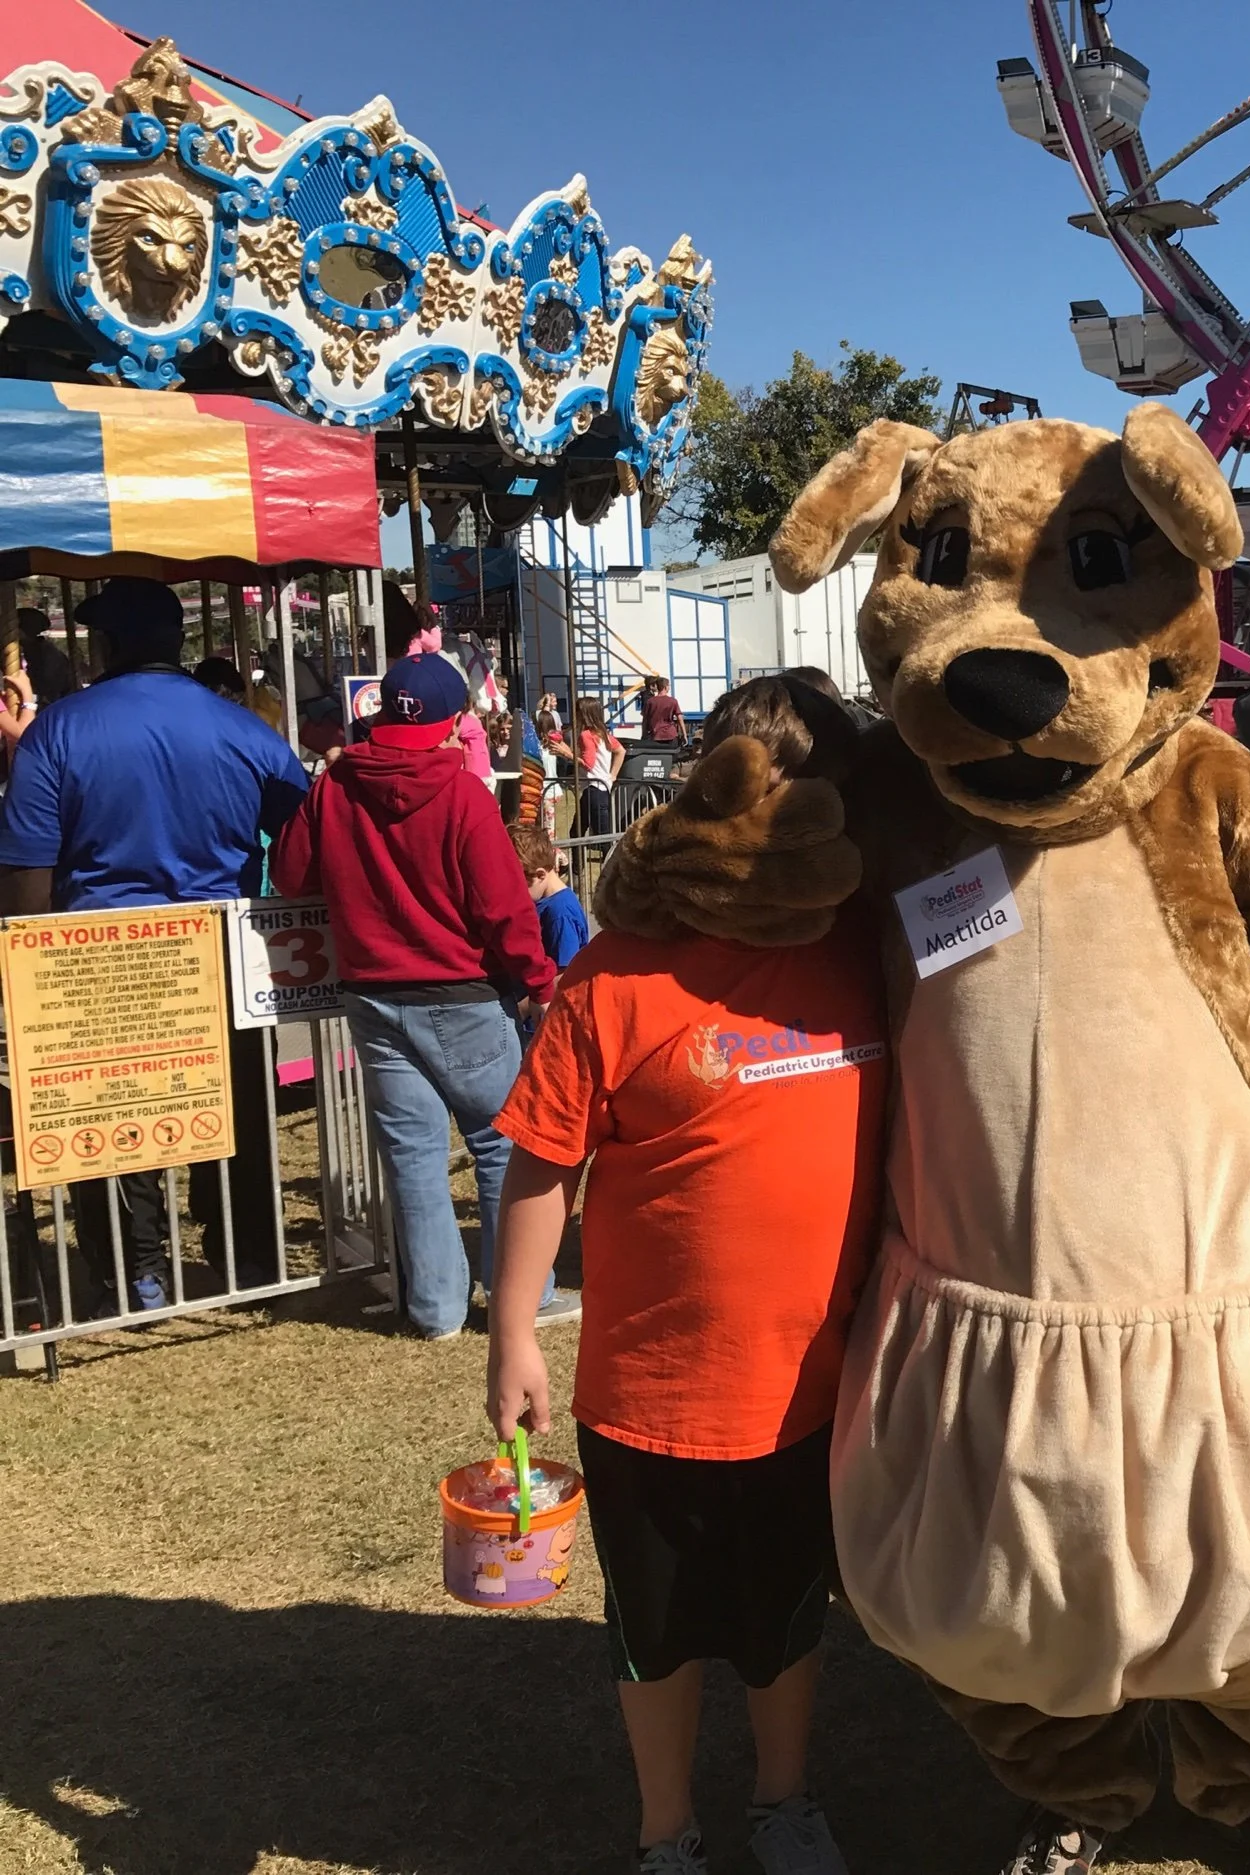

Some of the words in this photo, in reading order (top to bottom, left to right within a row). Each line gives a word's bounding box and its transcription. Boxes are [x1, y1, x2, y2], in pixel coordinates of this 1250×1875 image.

[1081, 49, 1102, 63] 13
[926, 876, 984, 912] PediStat
[246, 912, 293, 930] THIS
[301, 909, 330, 926] RID
[9, 930, 54, 949] FOR
[60, 925, 120, 945] YOUR
[126, 918, 209, 939] SAFETY:
[926, 908, 1008, 957] Matilda
[39, 948, 68, 958] OBSERVE
[110, 943, 123, 952] AND
[125, 941, 147, 951] WEIGHT
[149, 938, 192, 948] REQUIREMENTS
[54, 957, 79, 967] FOLLOW
[80, 953, 125, 965] INSTRUCTIONS
[126, 953, 134, 961] OF
[136, 951, 149, 960] RIDE
[151, 949, 180, 958] OPERATOR
[266, 927, 330, 988] 3
[111, 963, 126, 972] LEGS
[127, 961, 147, 970] INSIDE
[164, 959, 170, 967] AT
[171, 958, 181, 966] ALL
[183, 957, 199, 965] TIMES
[50, 979, 72, 988] SAFETY
[74, 975, 110, 986] EQUIPMENT
[111, 973, 127, 982] SUCH
[138, 971, 153, 980] SEAT
[170, 967, 199, 976] SHOULDER
[130, 982, 148, 990] WHEN
[149, 979, 177, 989] PROVIDED
[40, 1001, 62, 1010] WATCH
[63, 999, 75, 1008] THE
[77, 998, 91, 1006] RIDE
[100, 993, 134, 1004] OPERATION
[136, 992, 148, 1000] AND
[149, 990, 165, 999] MAKE
[167, 989, 181, 997] SURE
[183, 987, 198, 995] YOUR
[254, 983, 344, 1003] COUPONS
[83, 1007, 102, 1016] CHILD
[103, 1006, 115, 1014] CAN
[117, 1004, 130, 1012] RIDE
[132, 1003, 138, 1011] IT
[139, 1001, 161, 1010] SAFELY
[265, 1003, 277, 1012] NO
[277, 1000, 298, 1010] CASH
[300, 996, 338, 1008] ACCEPTED
[22, 1022, 54, 1033] CHILDREN
[55, 1020, 72, 1029] MUST
[73, 1018, 89, 1027] ABLE
[91, 1017, 99, 1025] TO
[118, 1011, 156, 1022] THEMSELVES
[157, 1008, 182, 1018] UPRIGHT
[183, 1007, 194, 1015] AND
[70, 1029, 90, 1038] SHOES
[110, 1026, 118, 1034] BE
[119, 1024, 136, 1033] WORN
[147, 1021, 157, 1029] ALL
[159, 1019, 176, 1028] TIMES
[33, 1045, 42, 1053] DO
[44, 1043, 56, 1052] NOT
[58, 1040, 78, 1050] FORCE
[85, 1037, 103, 1047] CHILD
[105, 1036, 113, 1044] TO
[114, 1035, 127, 1043] RIDE
[136, 1033, 144, 1041] HE
[155, 1030, 167, 1038] SHE
[168, 1029, 173, 1037] IS
[175, 1025, 209, 1036] FRIGHTENED
[30, 1068, 94, 1087] HEIGHT
[99, 1052, 219, 1078] RESTRICTIONS:
[744, 1058, 809, 1080] Pediatric
[811, 1050, 855, 1068] Urgent
[857, 1047, 882, 1059] Care
[105, 1080, 120, 1090] THIS
[122, 1078, 137, 1088] TALL
[170, 1082, 186, 1092] OVER
[171, 1072, 184, 1082] NOT
[32, 1090, 48, 1100] THIS
[49, 1087, 66, 1098] TALL
[95, 1090, 125, 1102] WITHOUT
[127, 1087, 148, 1098] ADULT
[28, 1118, 66, 1132] PLEASE
[68, 1112, 112, 1126] OBSERVE
[115, 1108, 134, 1120] THE
[137, 1101, 189, 1117] FOLLOWING
[191, 1096, 222, 1108] RULES:
[29, 1101, 47, 1112] WITH
[48, 1098, 70, 1109] ADULT
